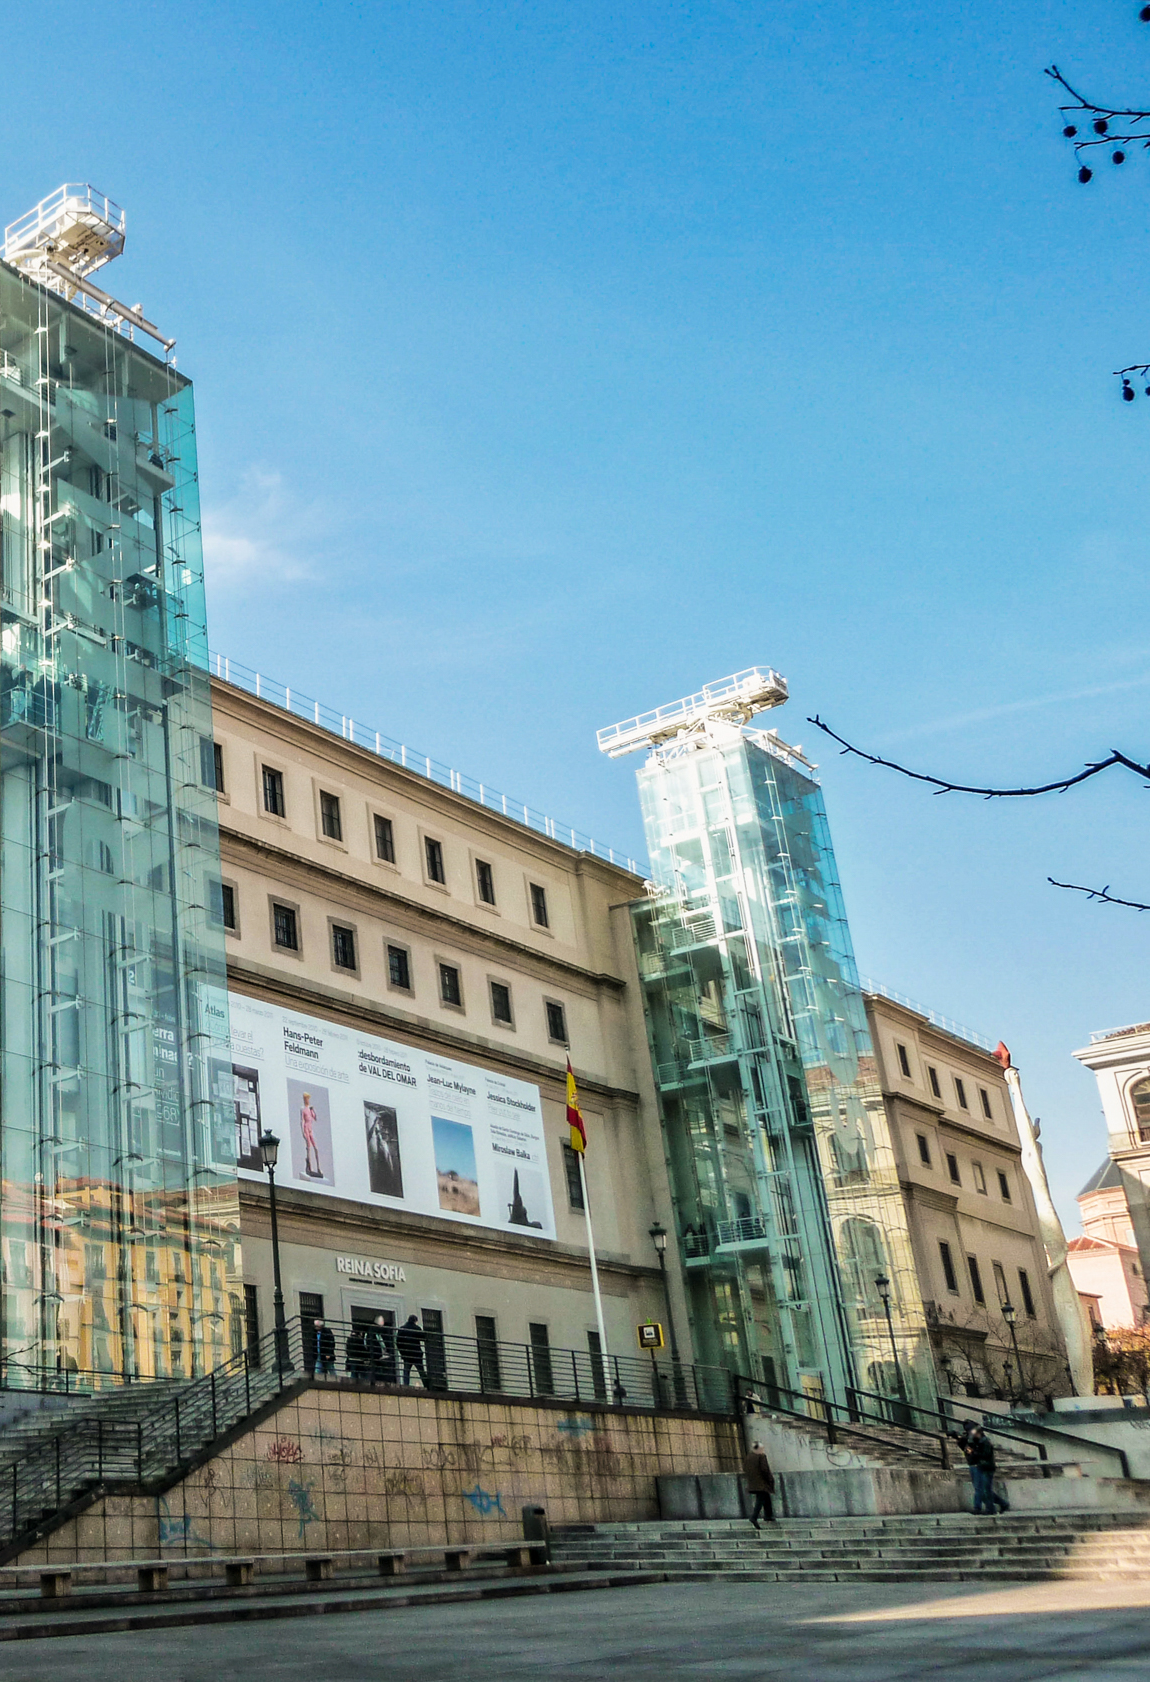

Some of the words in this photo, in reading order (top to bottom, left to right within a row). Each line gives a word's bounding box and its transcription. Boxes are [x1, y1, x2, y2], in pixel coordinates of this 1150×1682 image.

[204, 1004, 225, 1019] Atlas
[283, 1026, 324, 1047] Hans-Peter
[284, 1040, 319, 1060] Feldmann
[359, 1062, 367, 1073] de
[368, 1064, 381, 1077] VAL
[382, 1068, 395, 1081] DEL
[396, 1072, 417, 1087] OMAR
[427, 1073, 453, 1089] Jean-Luc
[487, 1090, 506, 1104] Jessica
[336, 1256, 374, 1277] REINA
[373, 1262, 406, 1282] SOFIA
